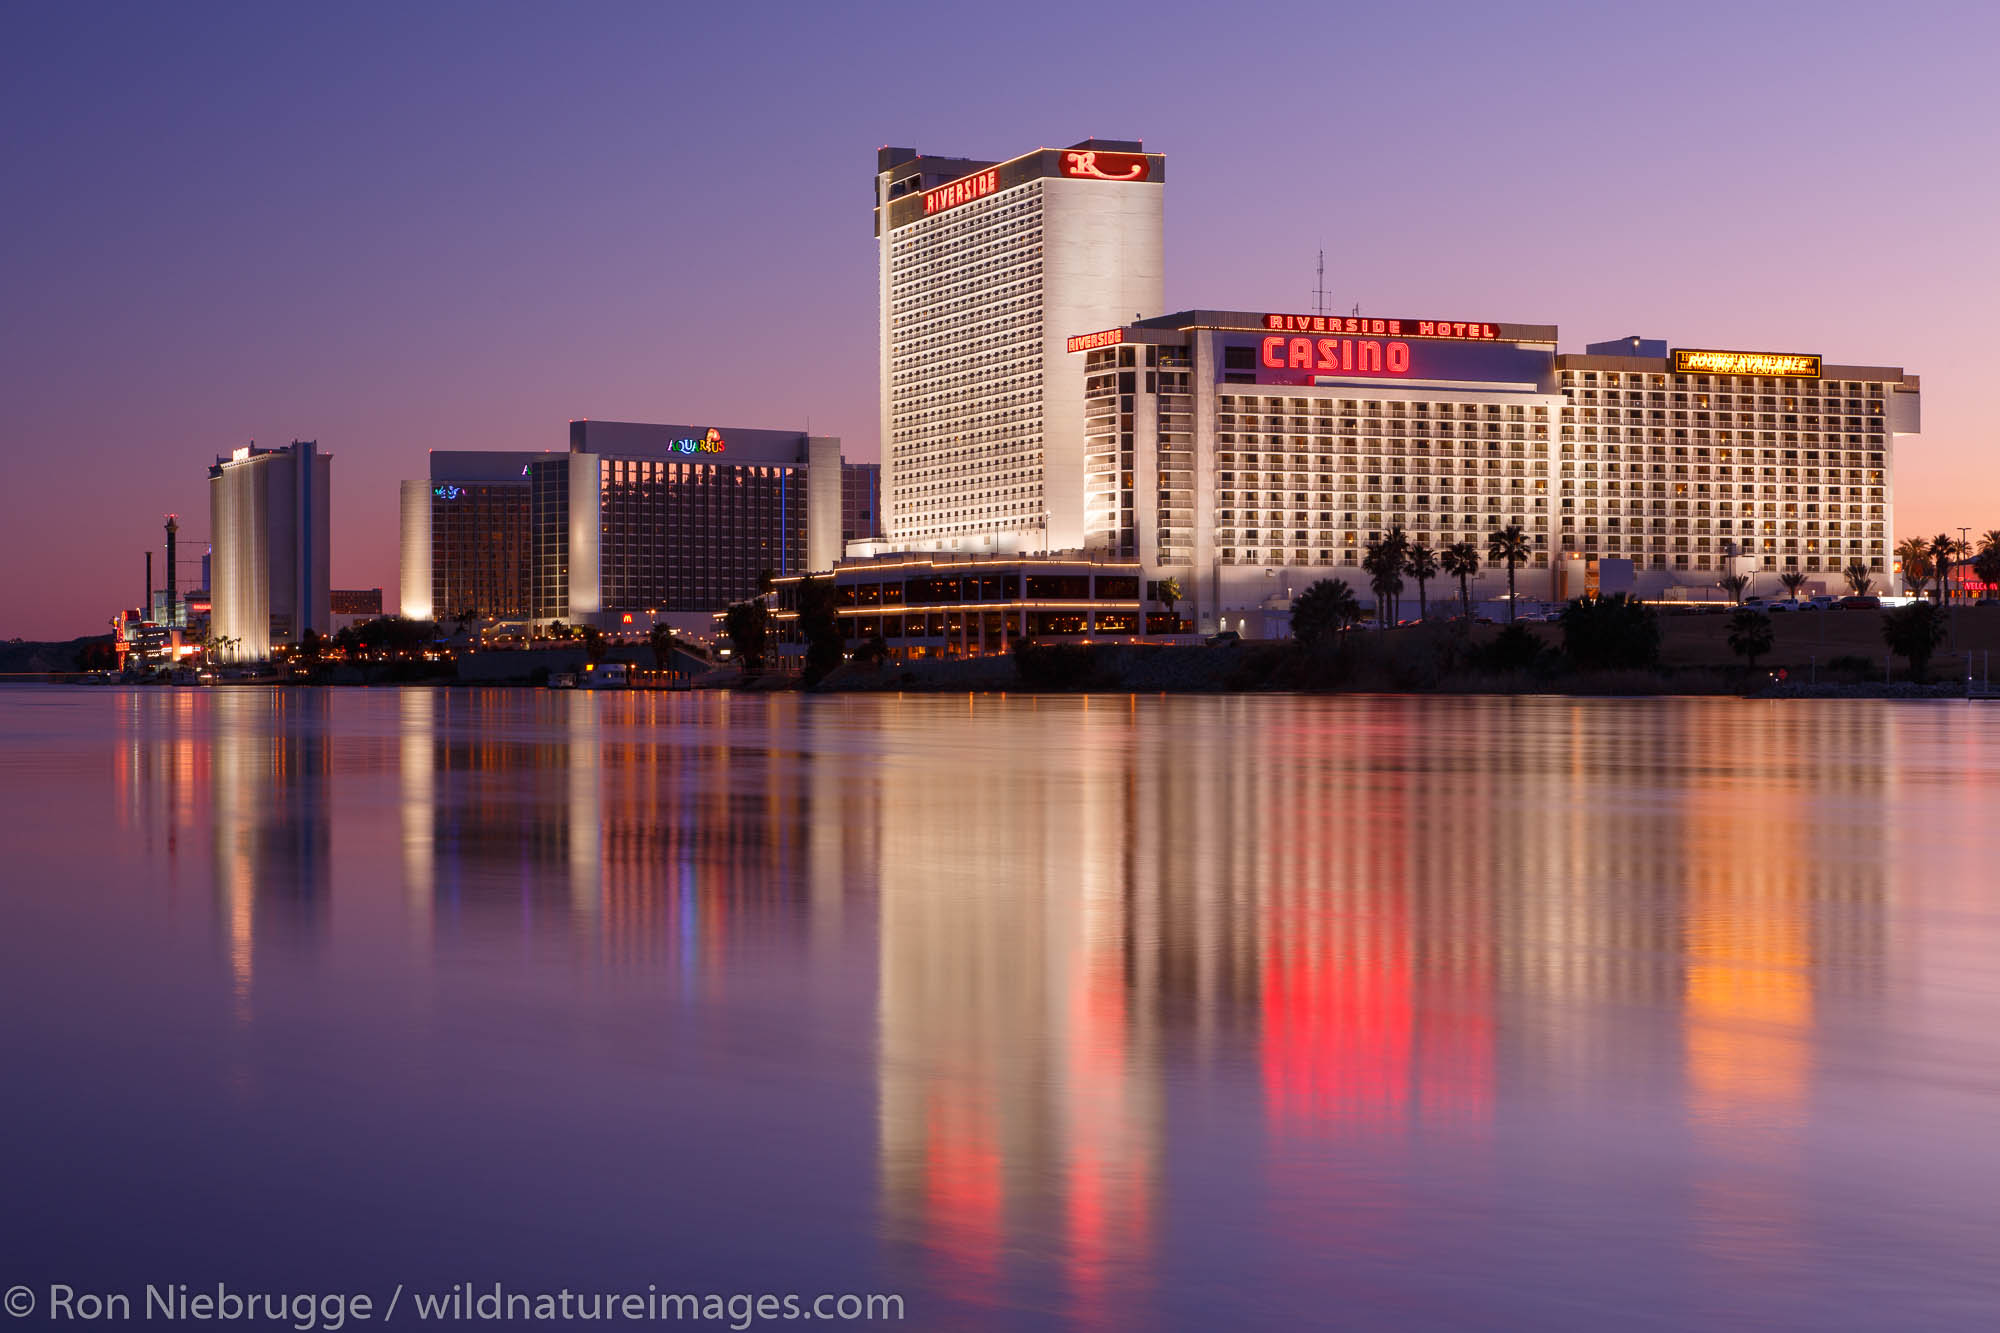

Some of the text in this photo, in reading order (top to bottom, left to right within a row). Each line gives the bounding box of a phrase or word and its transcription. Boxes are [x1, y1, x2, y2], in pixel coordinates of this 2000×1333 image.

[926, 171, 996, 214] RIVERSIDE
[1269, 315, 1494, 338] RIVERSIDE HOTEL
[1068, 329, 1122, 352] RIVERSIDE
[1263, 336, 1409, 372] CASINO
[667, 435, 726, 454] AQUARIUS
